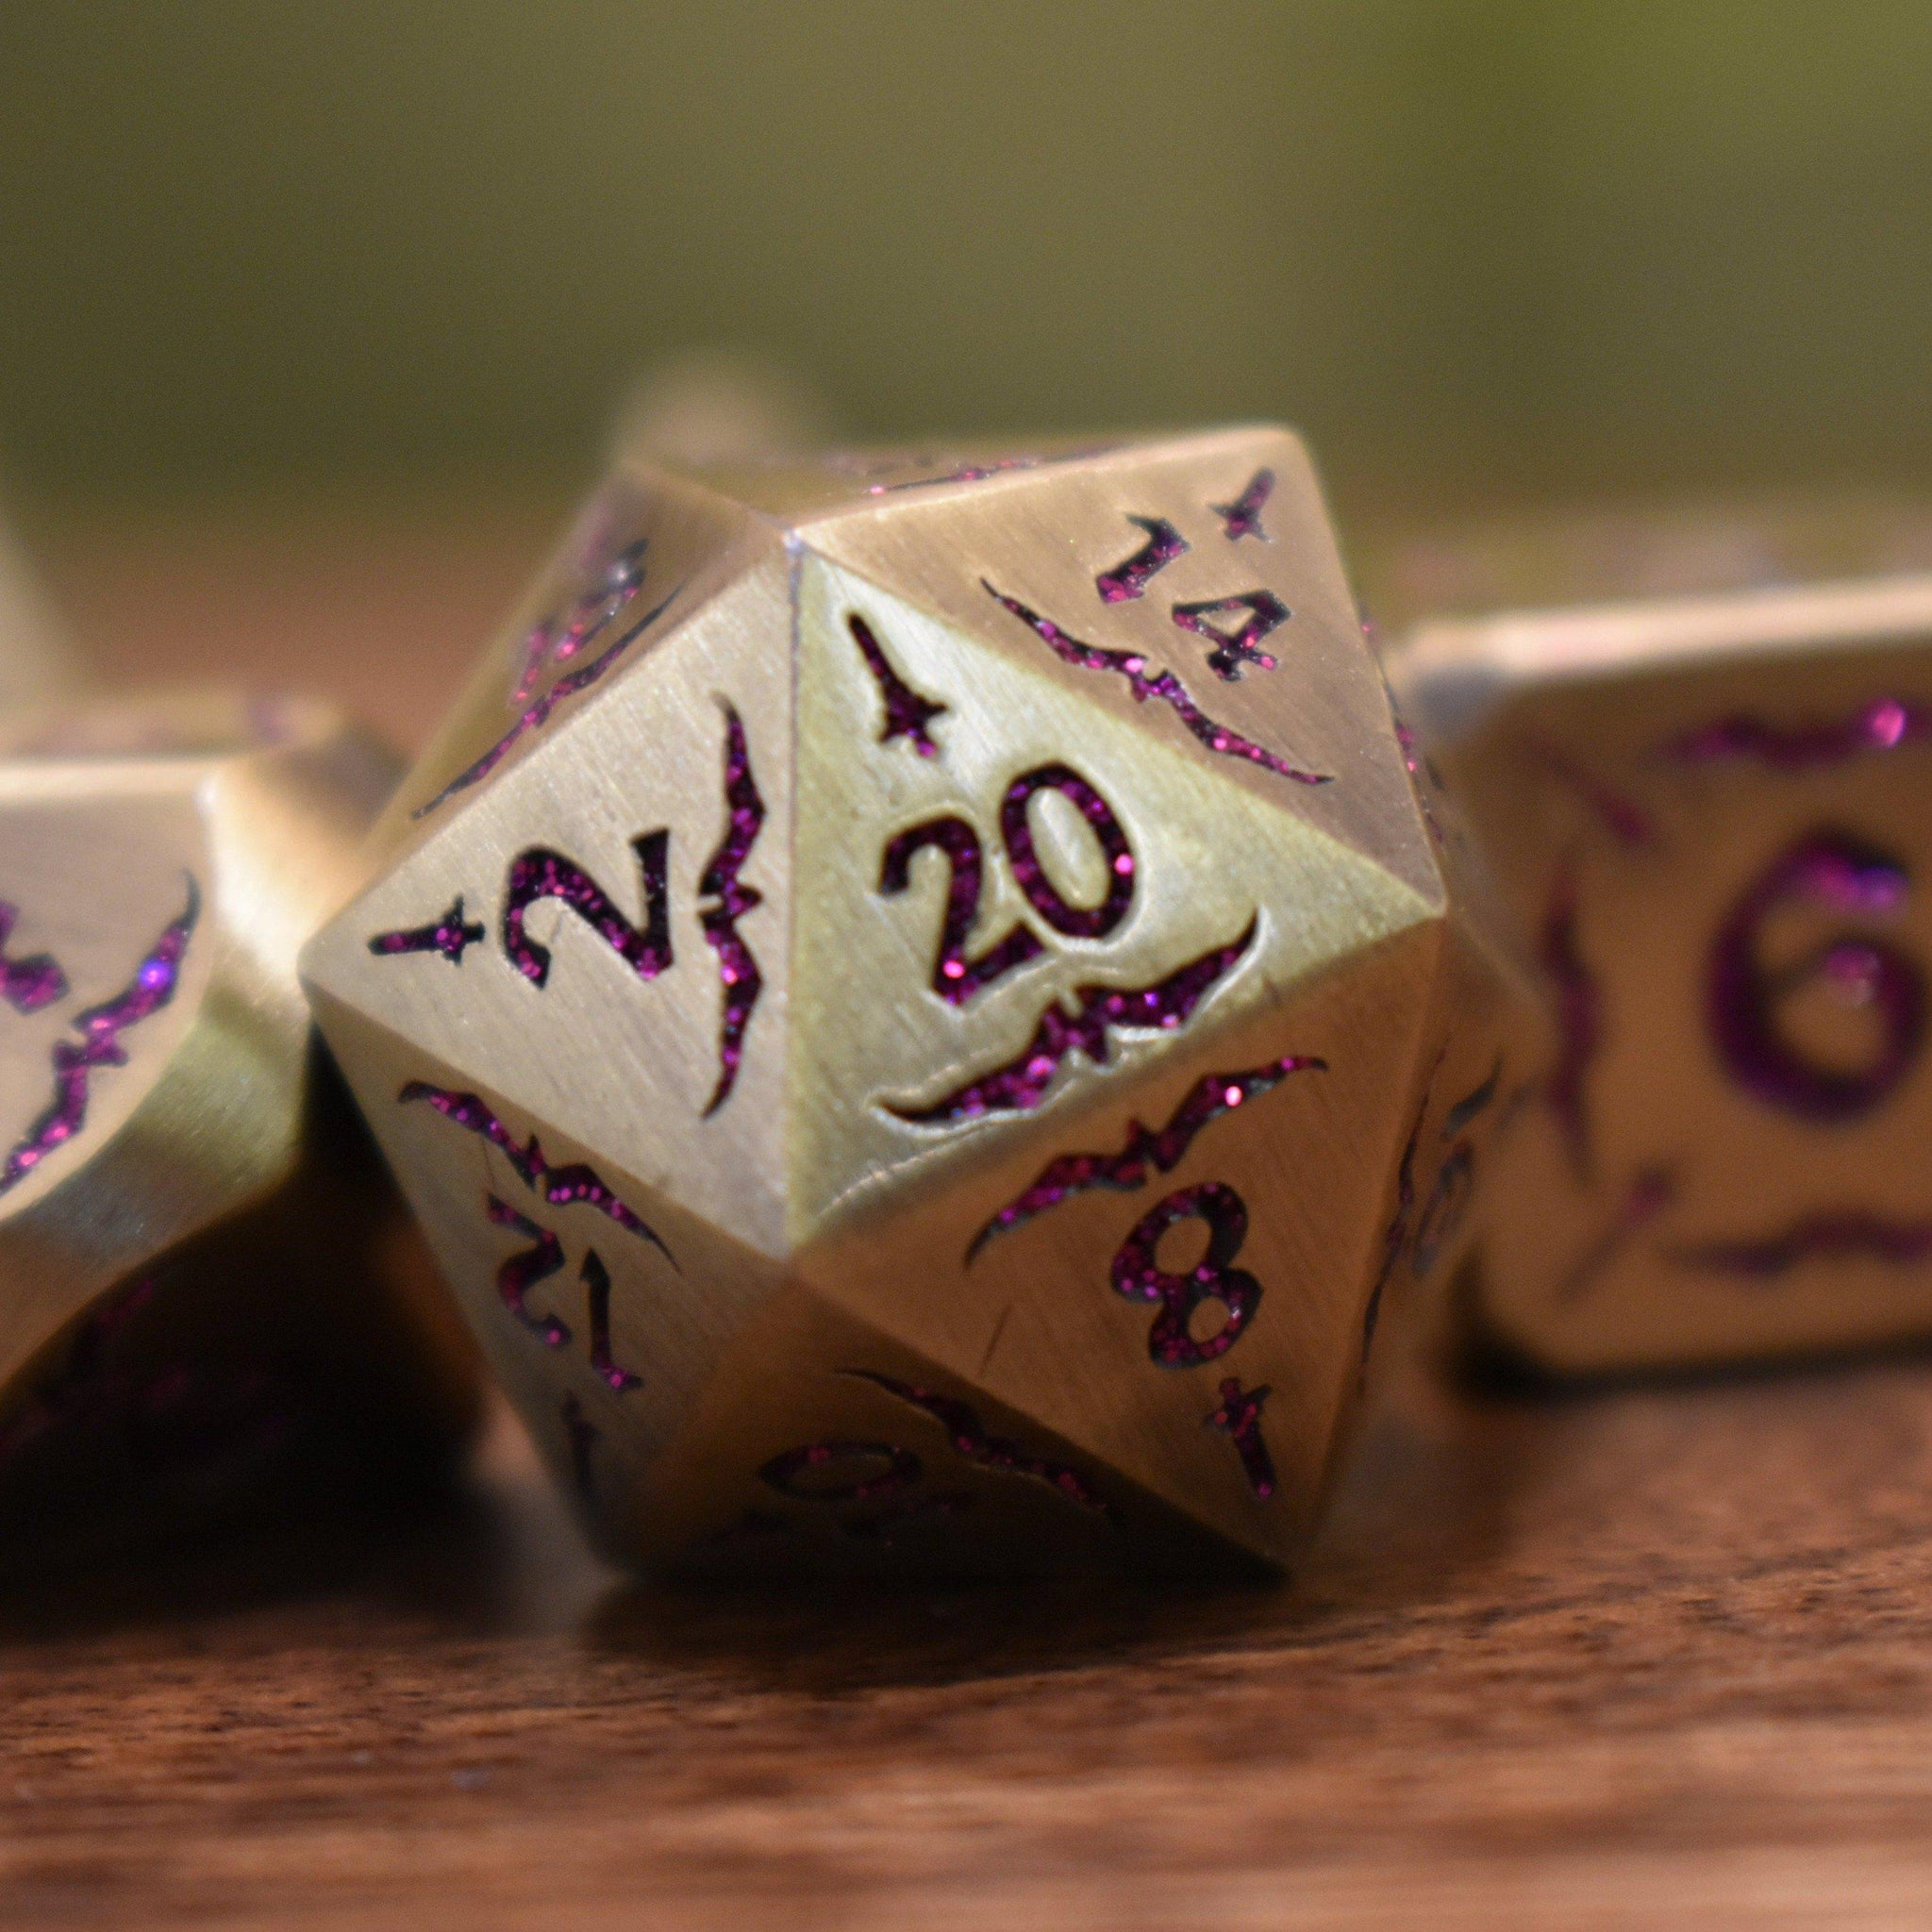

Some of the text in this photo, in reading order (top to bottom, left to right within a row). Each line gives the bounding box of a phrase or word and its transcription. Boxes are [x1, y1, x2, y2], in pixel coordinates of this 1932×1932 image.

[1095, 513, 1291, 681] 14
[502, 827, 674, 988] 2
[878, 762, 1138, 1005] 20
[1706, 824, 1929, 1124] 6
[487, 1190, 643, 1391] 12
[1111, 1182, 1264, 1369] 8
